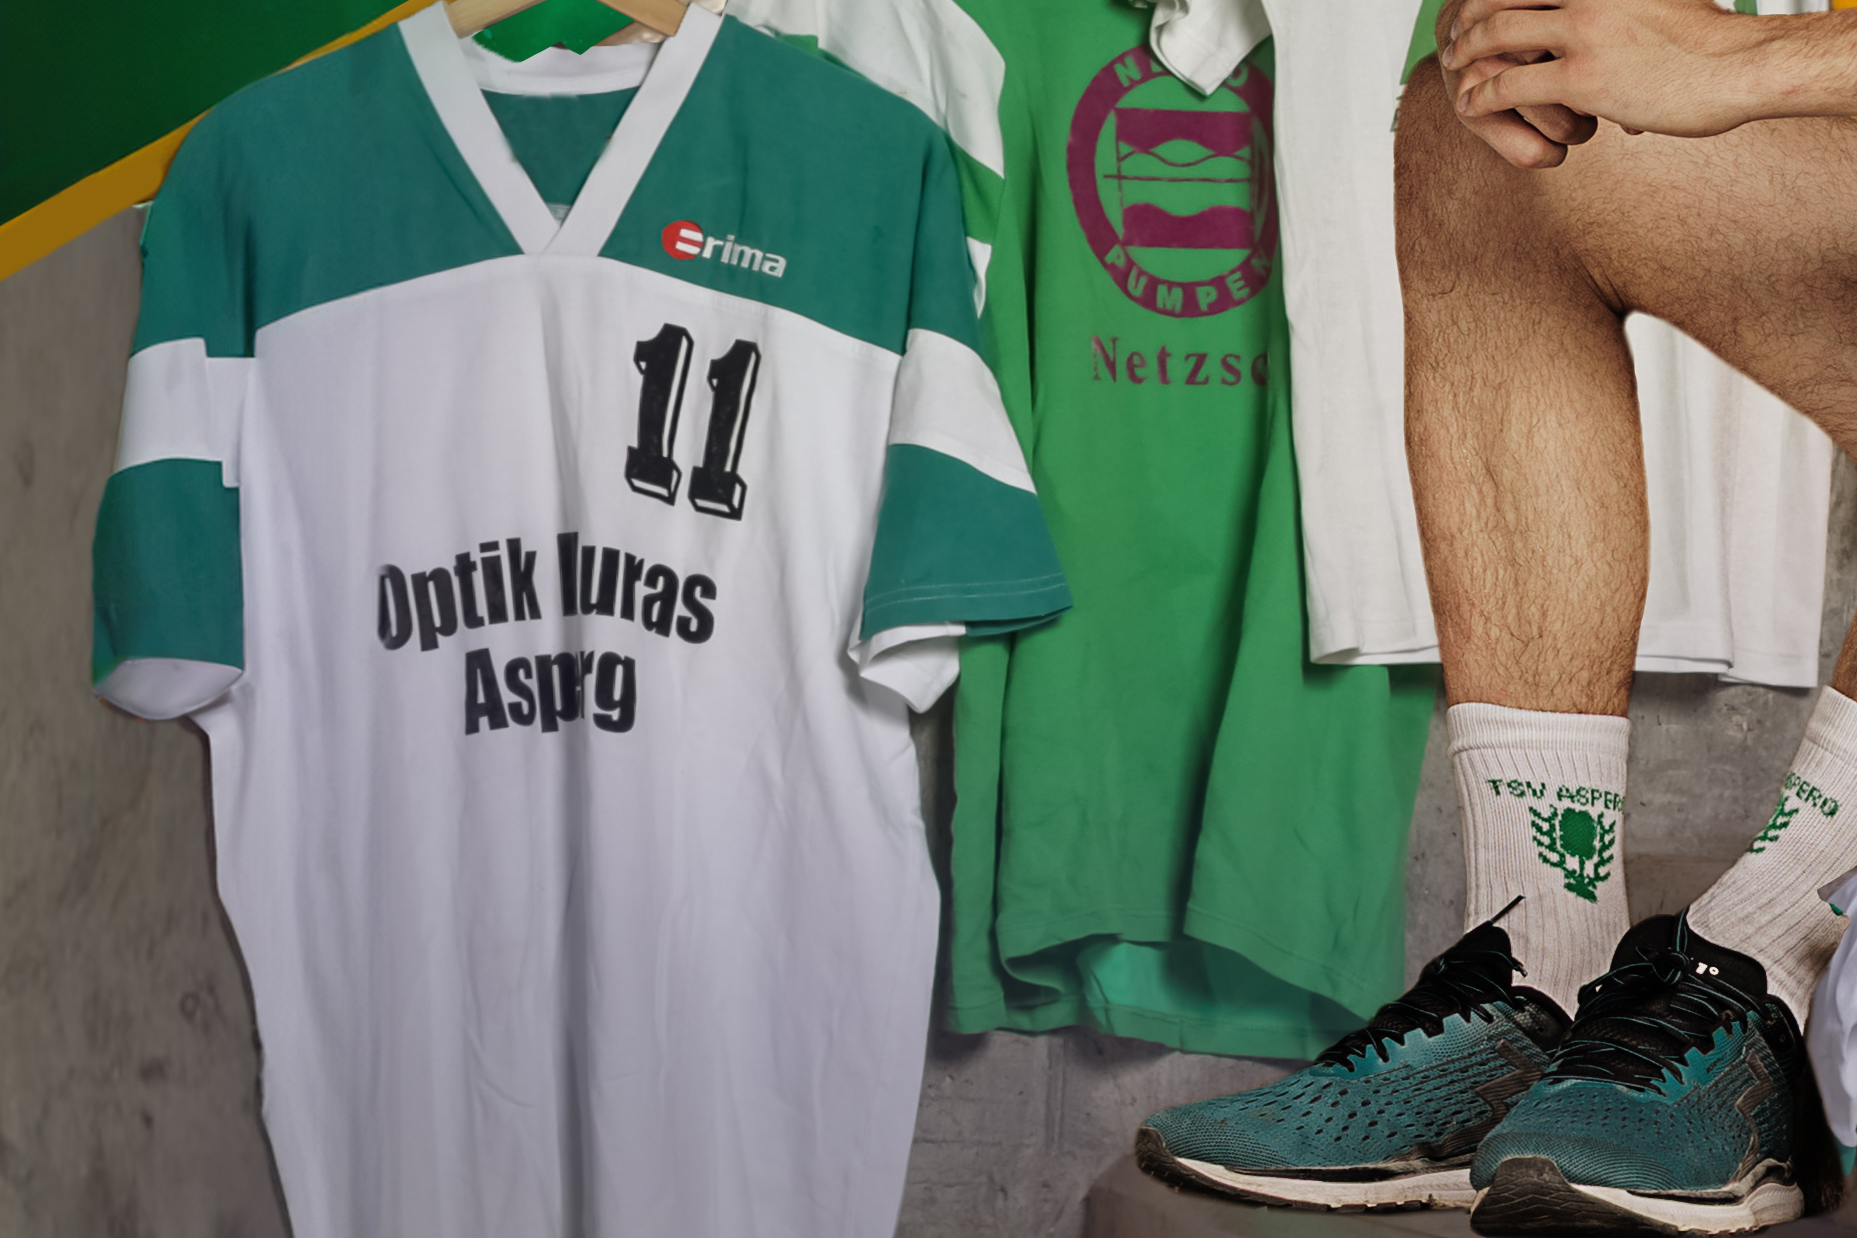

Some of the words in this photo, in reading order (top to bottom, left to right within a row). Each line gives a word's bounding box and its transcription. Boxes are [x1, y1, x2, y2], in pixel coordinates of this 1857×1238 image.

[624, 323, 762, 521] 11
[377, 537, 542, 652] Optik
[1486, 779, 1547, 799] TSV
